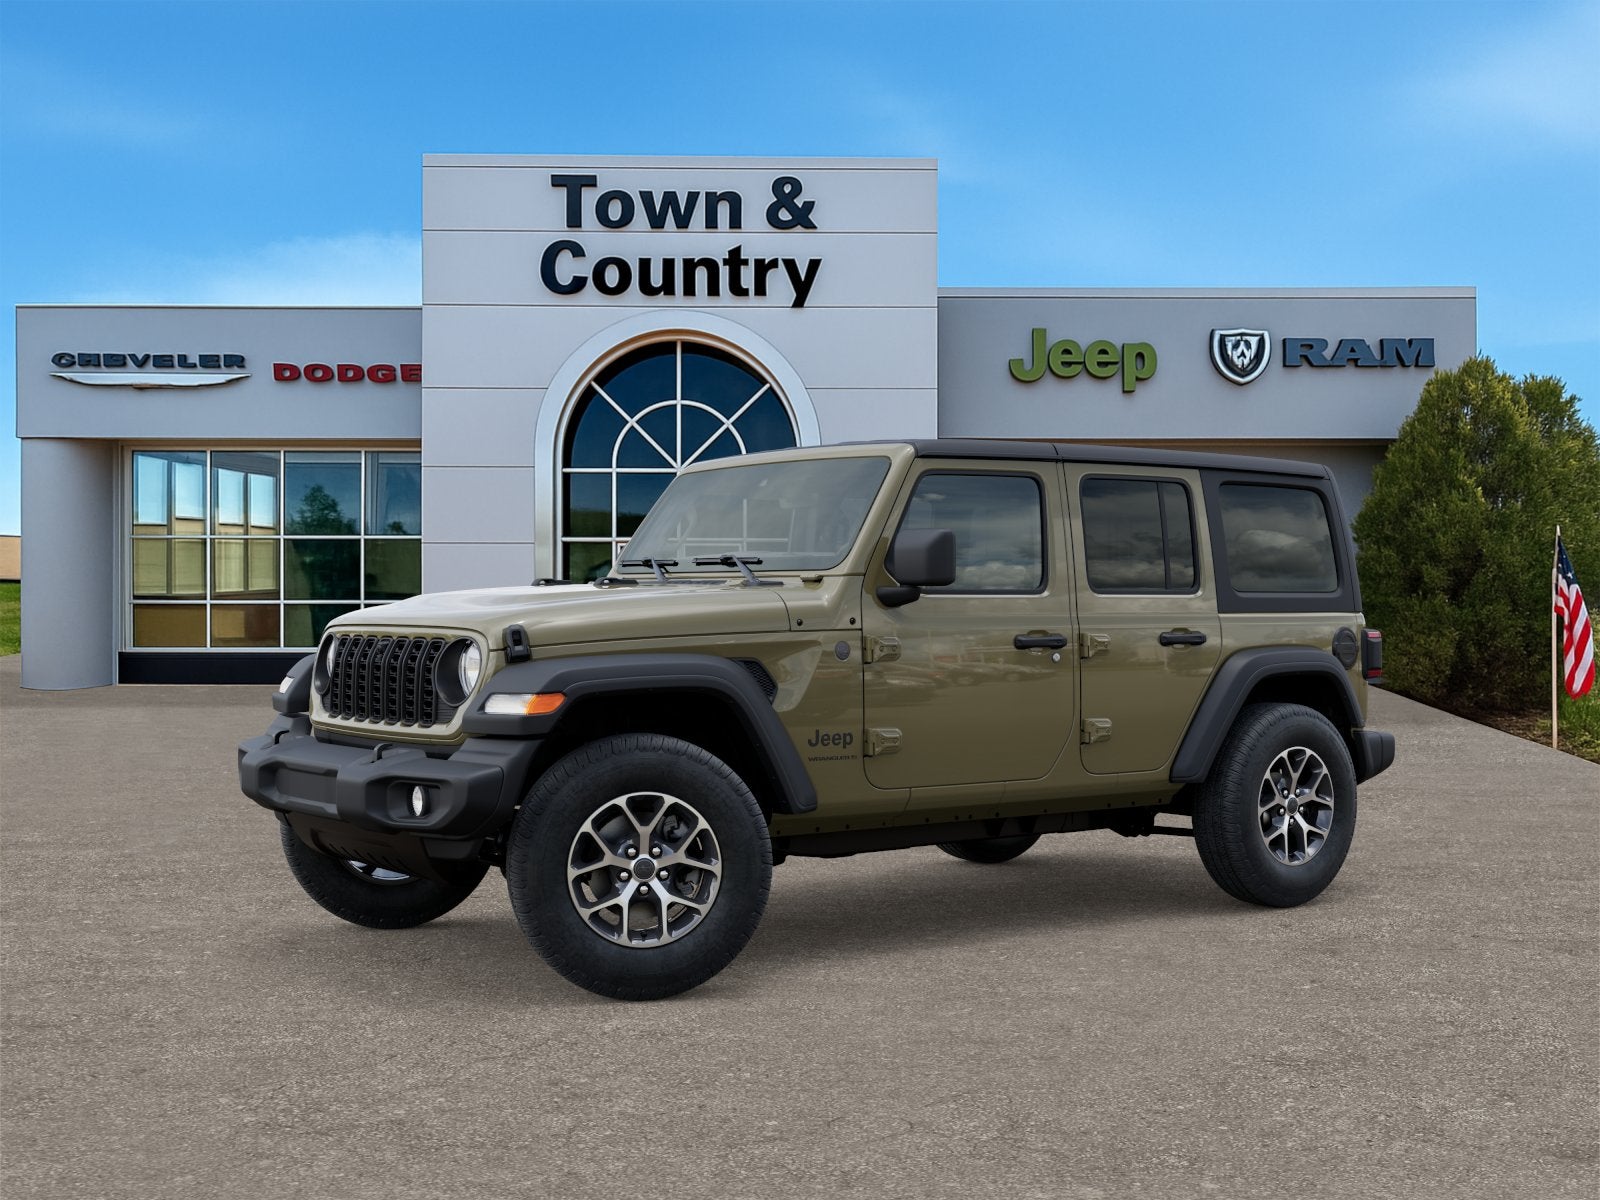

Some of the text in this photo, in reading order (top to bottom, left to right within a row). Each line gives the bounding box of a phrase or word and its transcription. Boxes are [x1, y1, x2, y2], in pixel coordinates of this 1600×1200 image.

[551, 174, 818, 230] Town &
[540, 239, 822, 308] Country
[273, 362, 422, 383] DODGE
[1008, 327, 1157, 393] Jeep
[1282, 337, 1436, 368] RAM
[807, 729, 853, 749] Jeep
